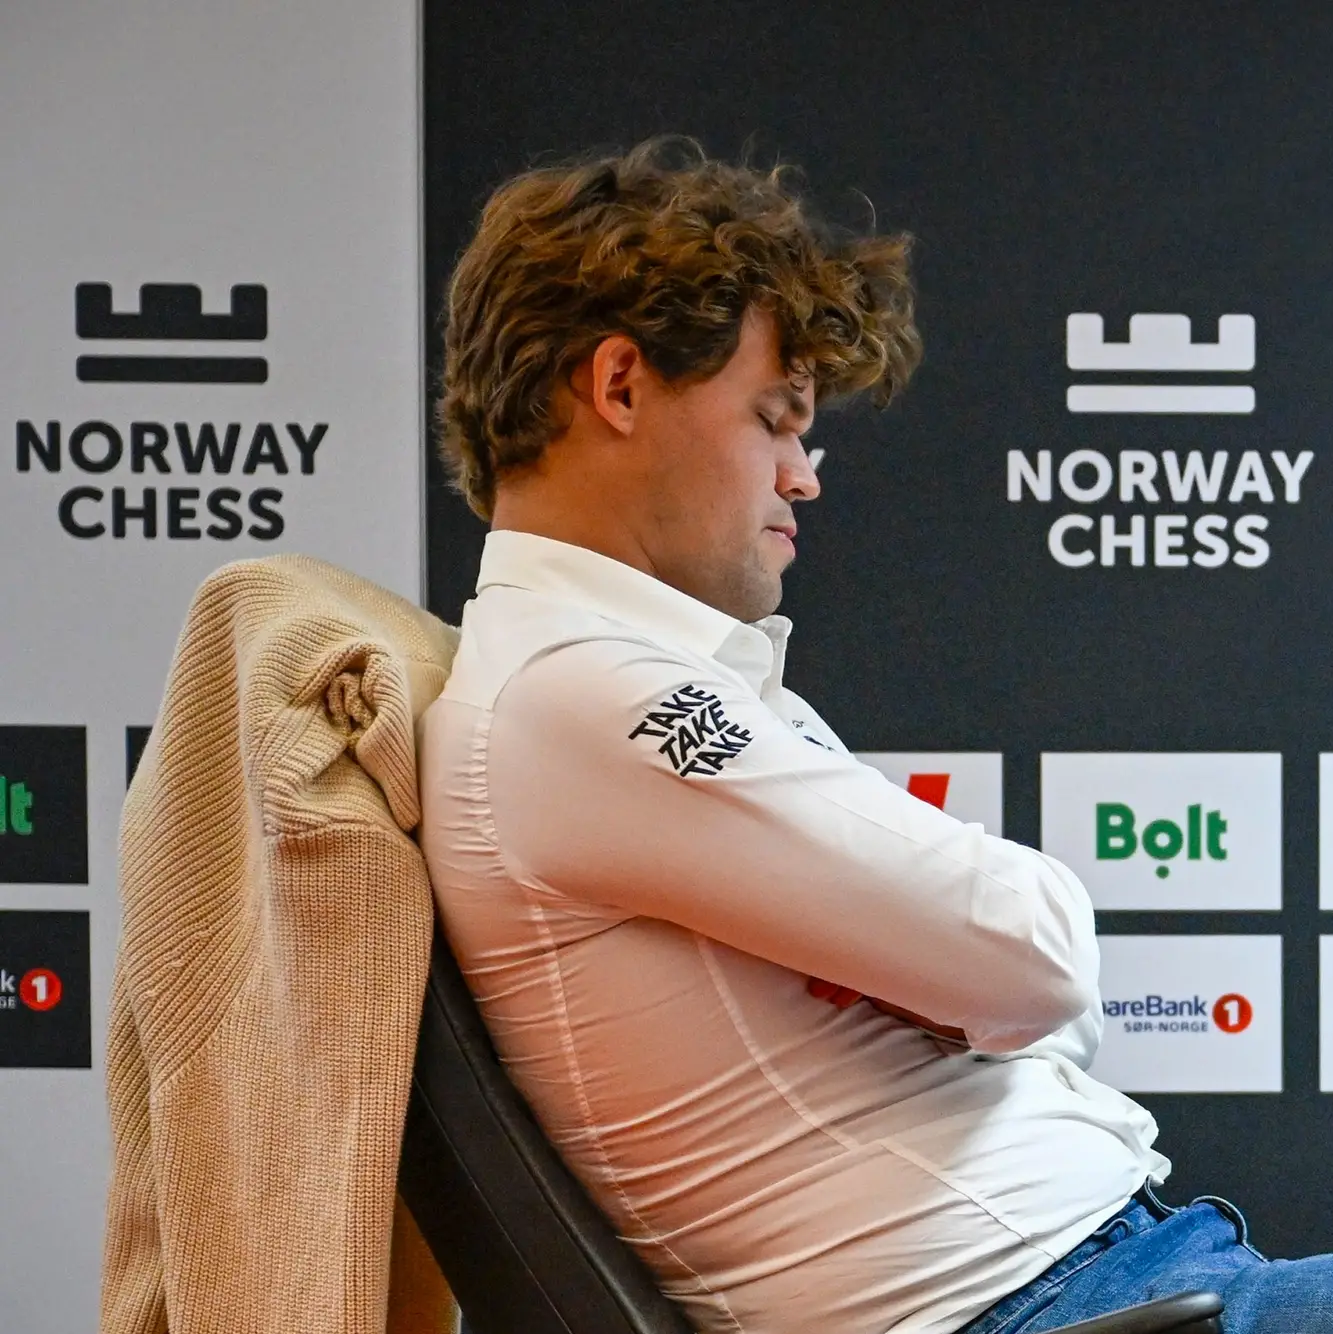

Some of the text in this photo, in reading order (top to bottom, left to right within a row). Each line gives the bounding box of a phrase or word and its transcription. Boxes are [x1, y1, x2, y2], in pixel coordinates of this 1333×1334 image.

[16, 420, 328, 475] NORWAY
[1008, 450, 1314, 503] NORWAY
[58, 486, 284, 541] CHESS
[1048, 514, 1270, 568] CHESS
[628, 684, 718, 740] TAKE
[658, 700, 730, 770] TAKE
[679, 723, 755, 778] TAKE
[1096, 803, 1227, 879] Bolt
[1102, 994, 1208, 1018] areBank
